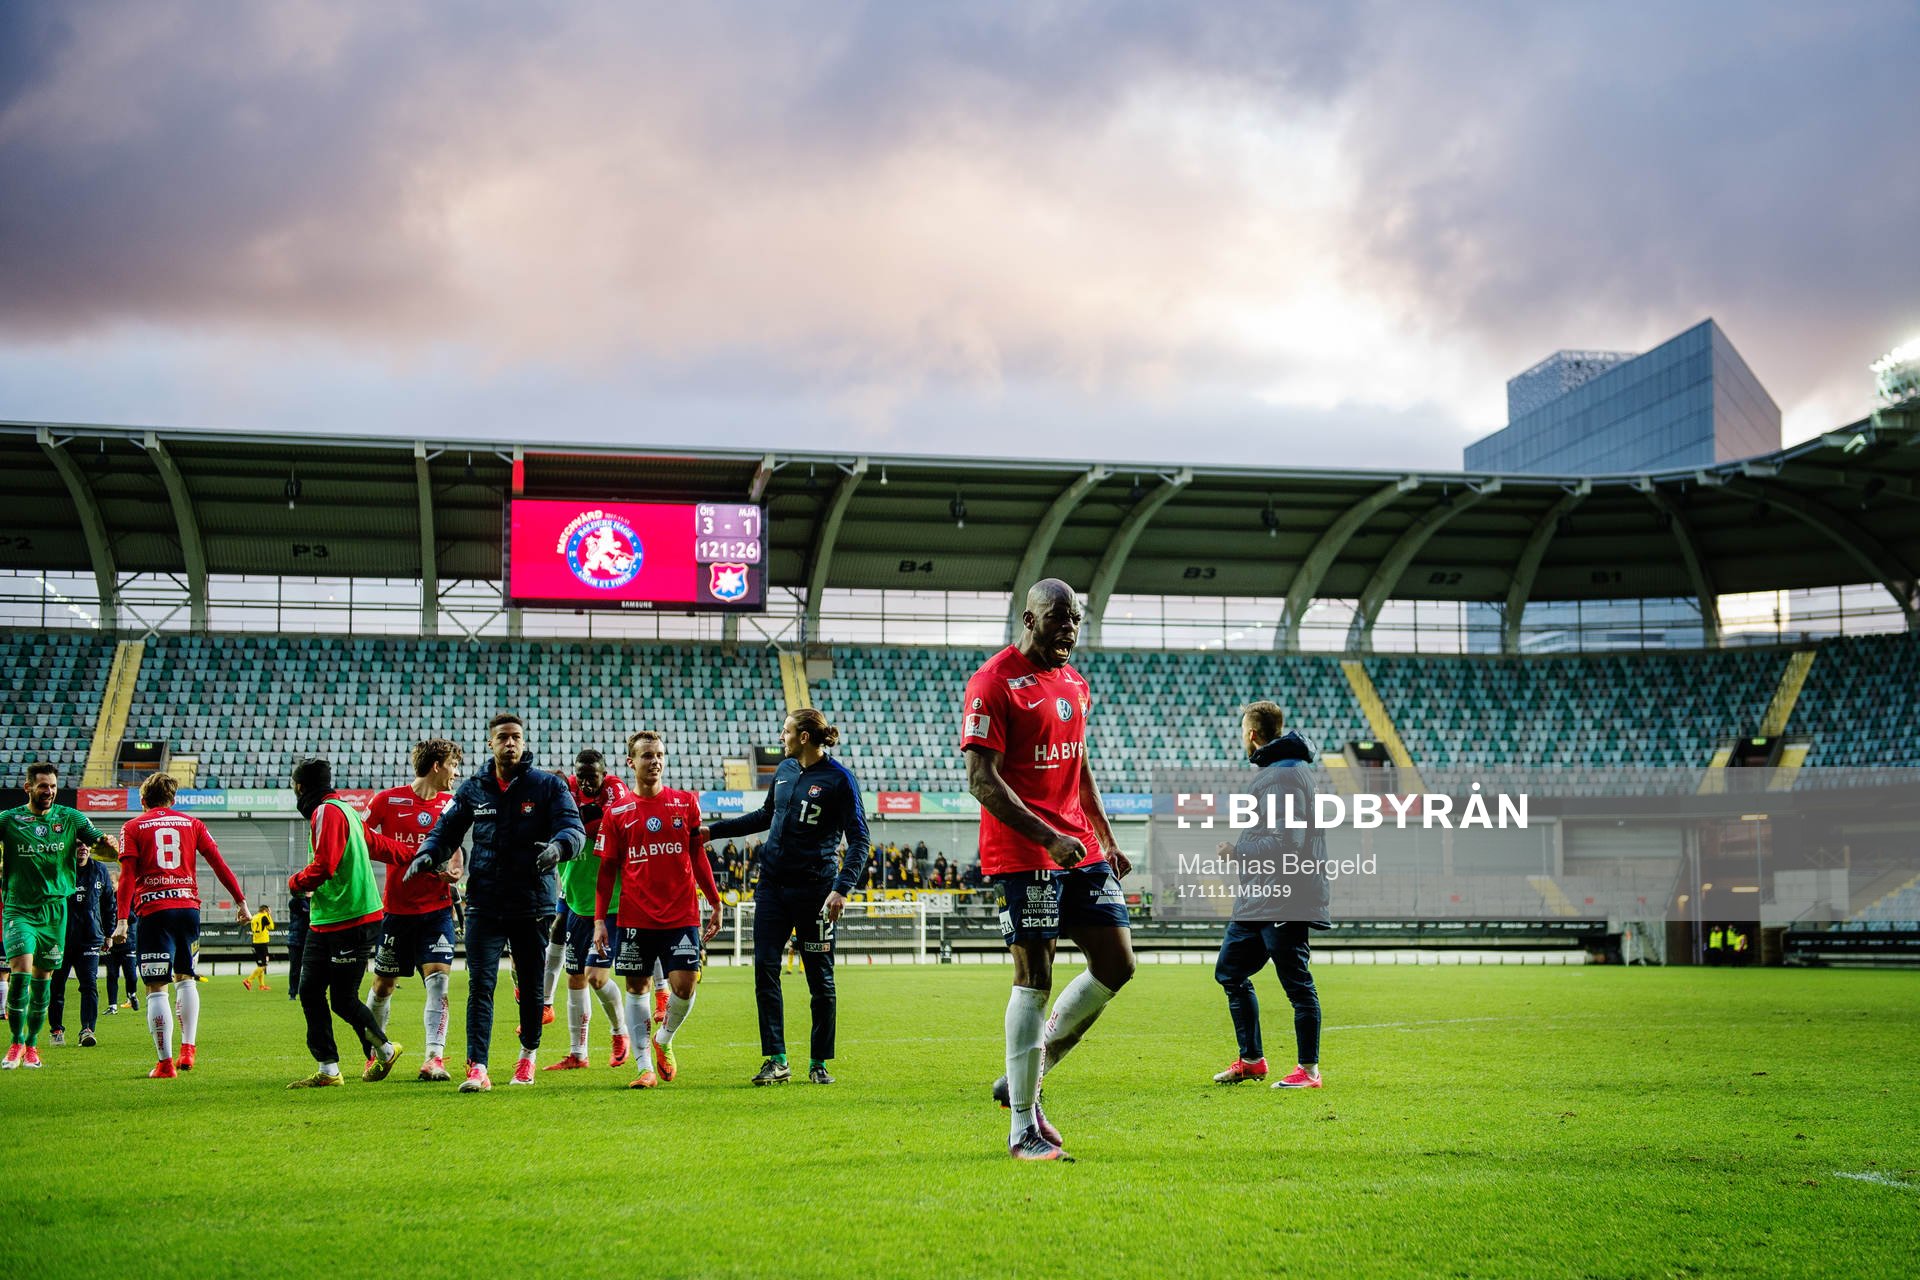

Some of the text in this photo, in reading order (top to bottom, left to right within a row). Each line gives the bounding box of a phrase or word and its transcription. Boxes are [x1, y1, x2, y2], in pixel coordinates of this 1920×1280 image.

[703, 516, 714, 534] 3
[743, 518, 752, 536] 1
[700, 541, 757, 559] 121:26
[899, 559, 934, 574] B4
[621, 600, 653, 609] SAMSUNG
[799, 800, 822, 825] 12
[138, 820, 193, 830] HAMMARVIKEN
[154, 827, 181, 870] 8
[649, 842, 683, 856] BYGG
[626, 928, 637, 940] 19
[815, 918, 834, 941] 12
[383, 933, 395, 947] 14
